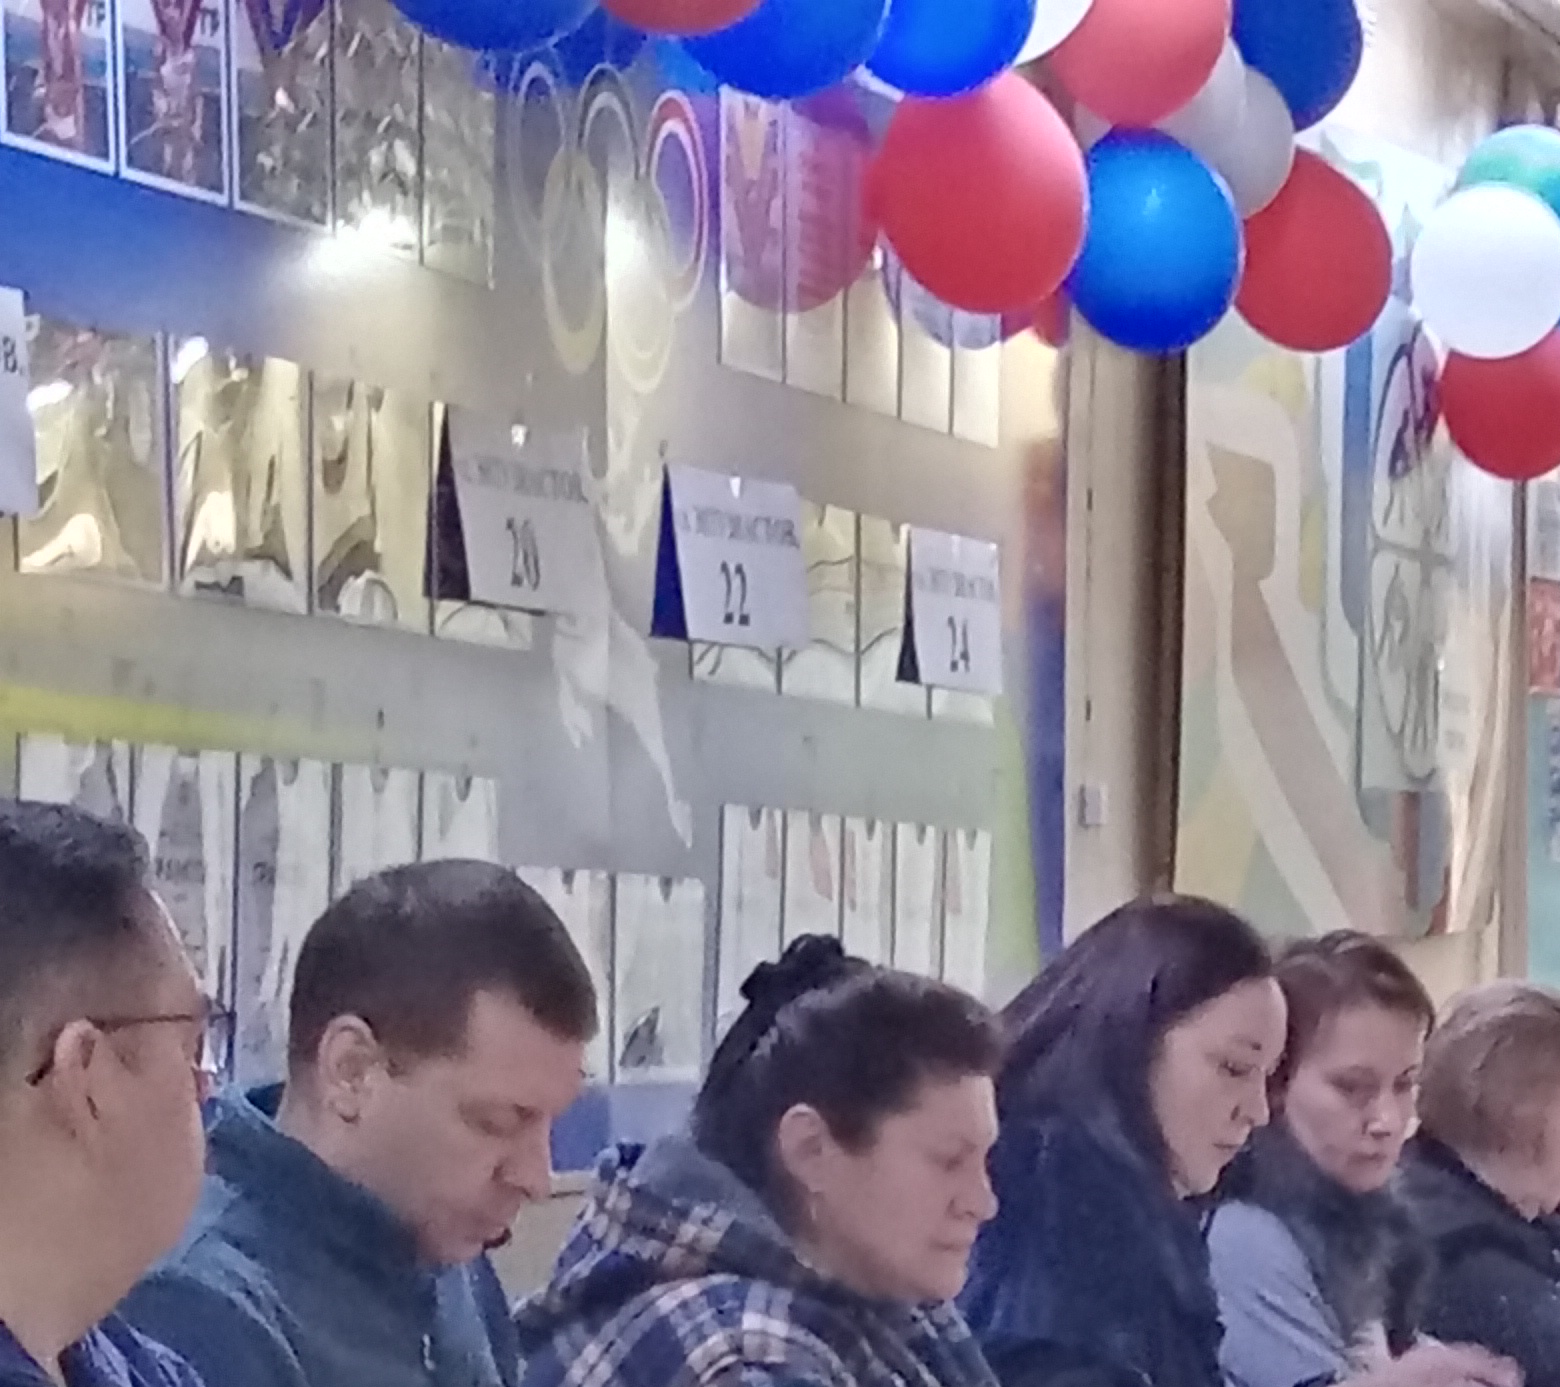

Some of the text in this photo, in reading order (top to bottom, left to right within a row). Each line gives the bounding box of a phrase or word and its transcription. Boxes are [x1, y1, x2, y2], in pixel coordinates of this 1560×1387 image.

[505, 515, 541, 593] 20
[719, 559, 750, 626] 22
[947, 614, 971, 673] 24
